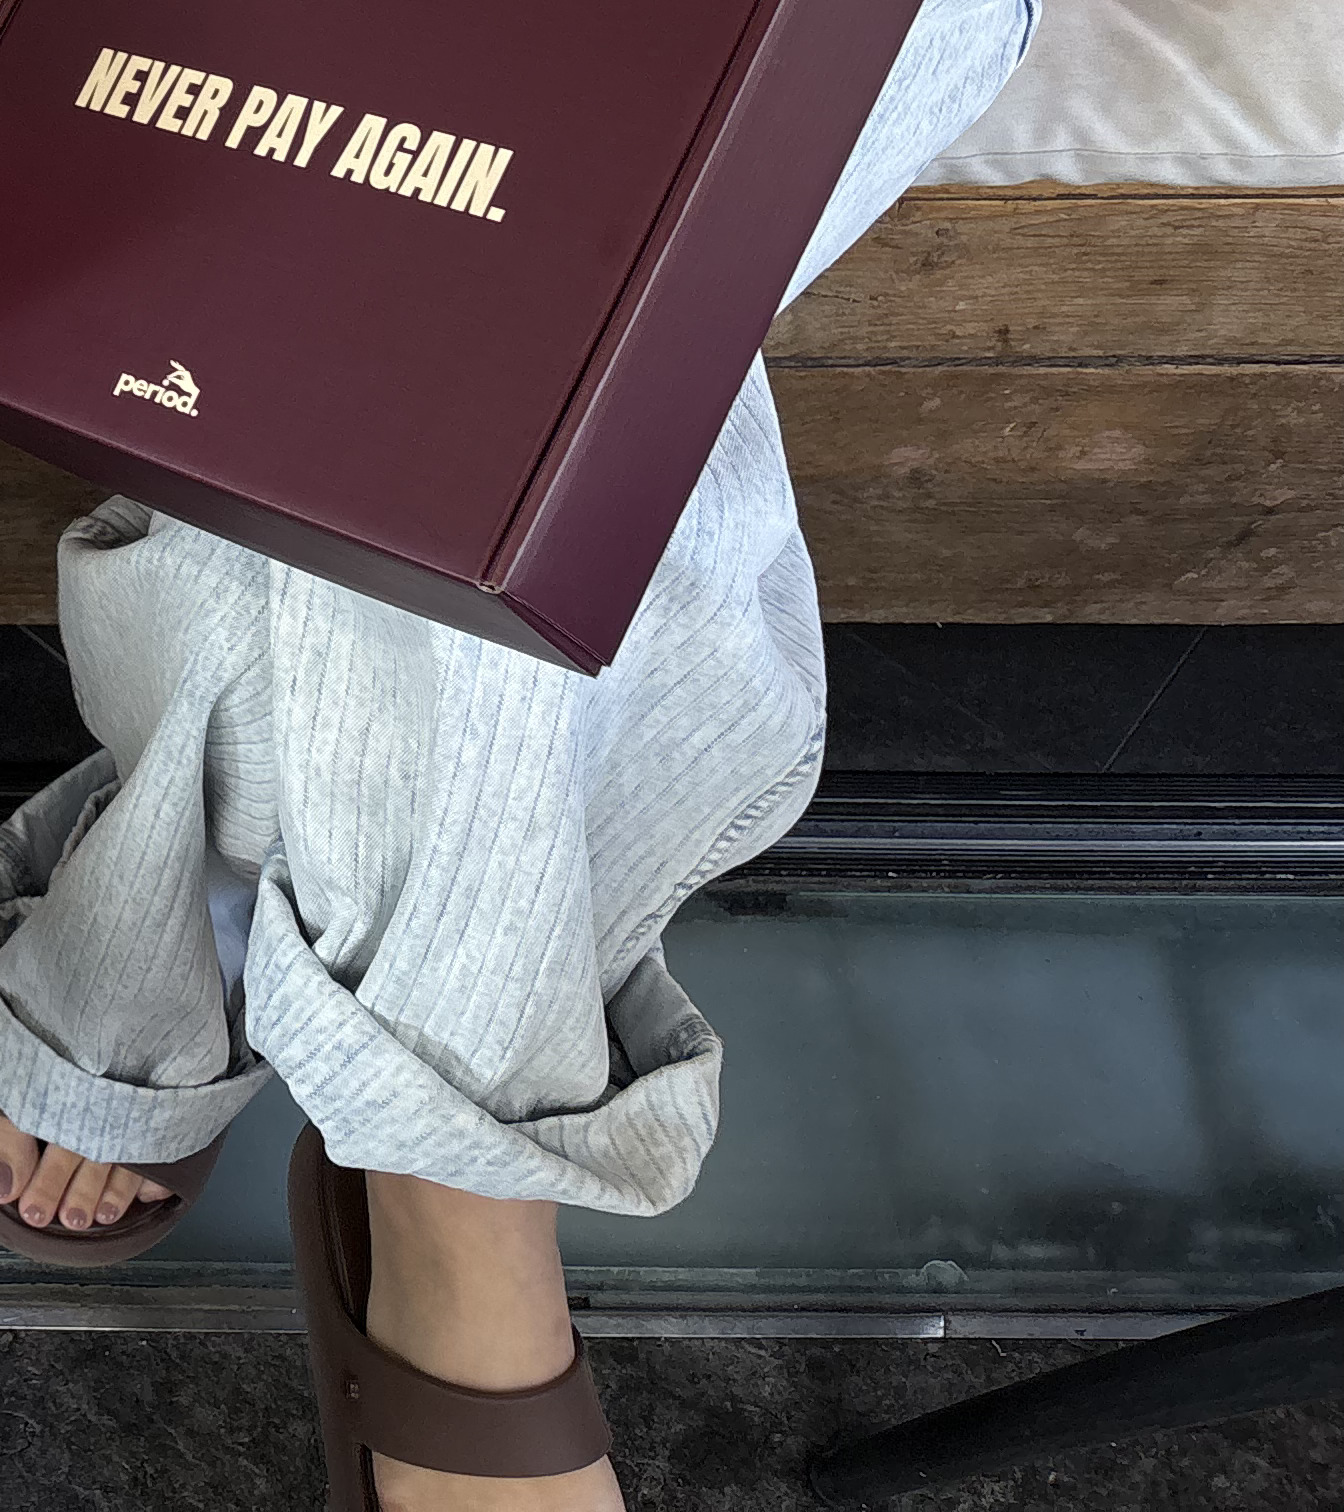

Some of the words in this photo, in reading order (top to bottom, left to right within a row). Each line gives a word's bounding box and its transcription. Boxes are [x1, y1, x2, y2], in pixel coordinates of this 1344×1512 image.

[74, 47, 233, 141] NEVER
[224, 85, 345, 168] PAY
[330, 113, 514, 223] AGAIN.
[113, 372, 201, 417] period.
